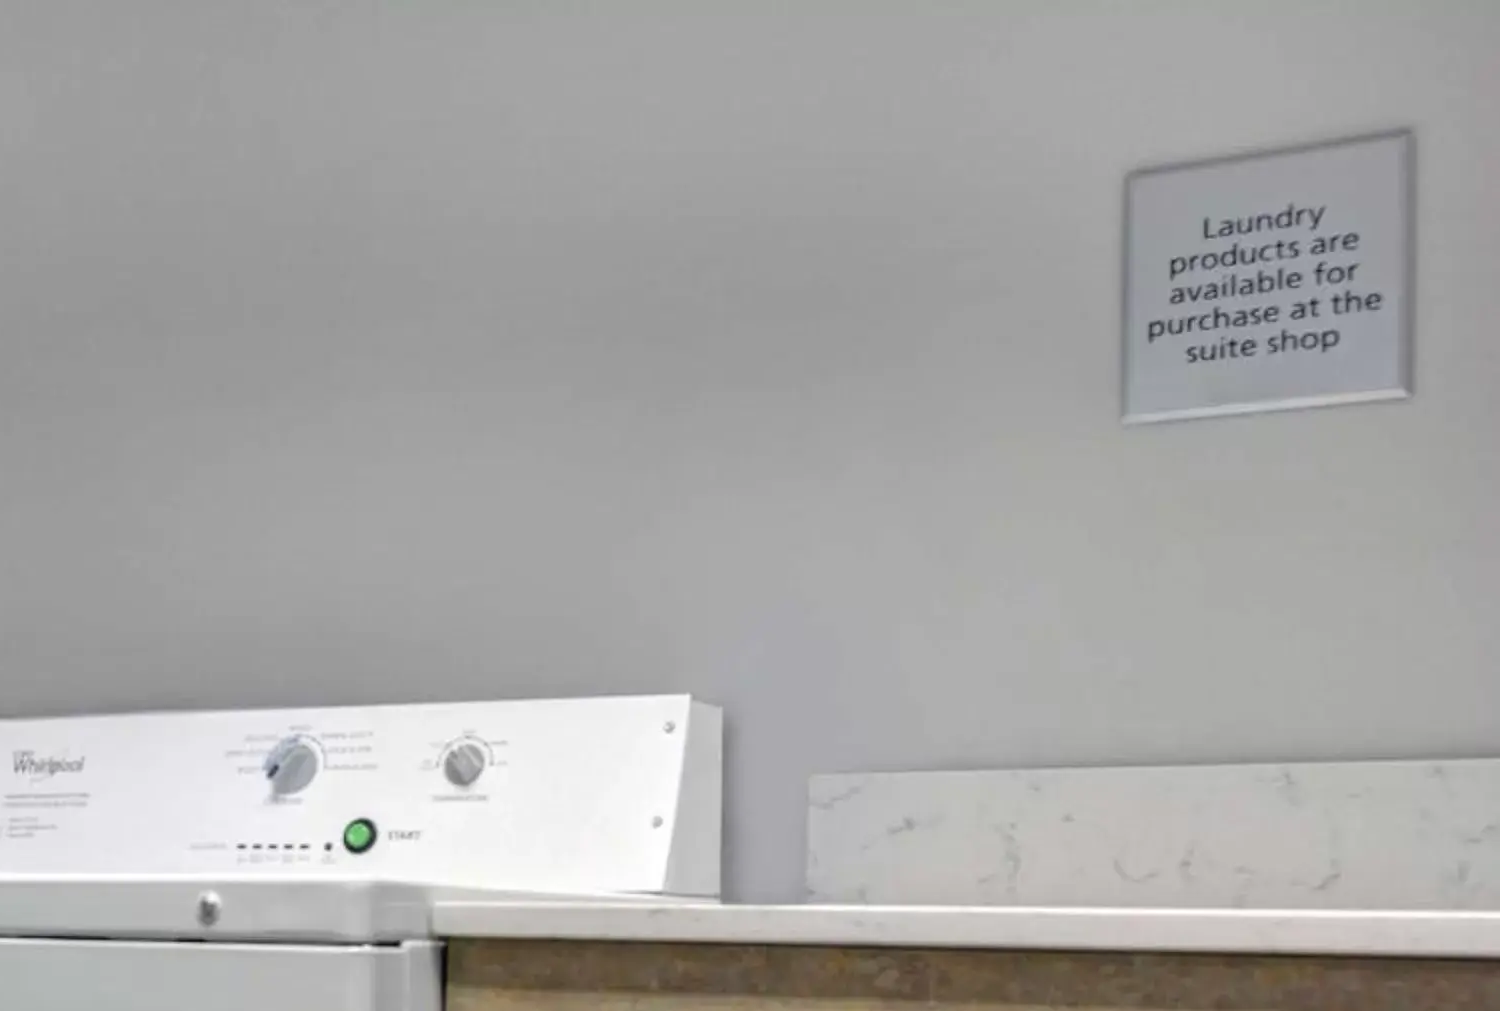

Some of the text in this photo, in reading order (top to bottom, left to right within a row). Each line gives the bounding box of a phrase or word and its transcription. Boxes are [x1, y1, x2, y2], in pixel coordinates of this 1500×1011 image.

[1202, 203, 1326, 240] Laundry
[1169, 231, 1360, 280] products are
[1168, 261, 1360, 305] available for
[1147, 289, 1383, 343] purchase at the
[1185, 328, 1341, 364] suite shop
[13, 755, 86, 776] Whirlpool
